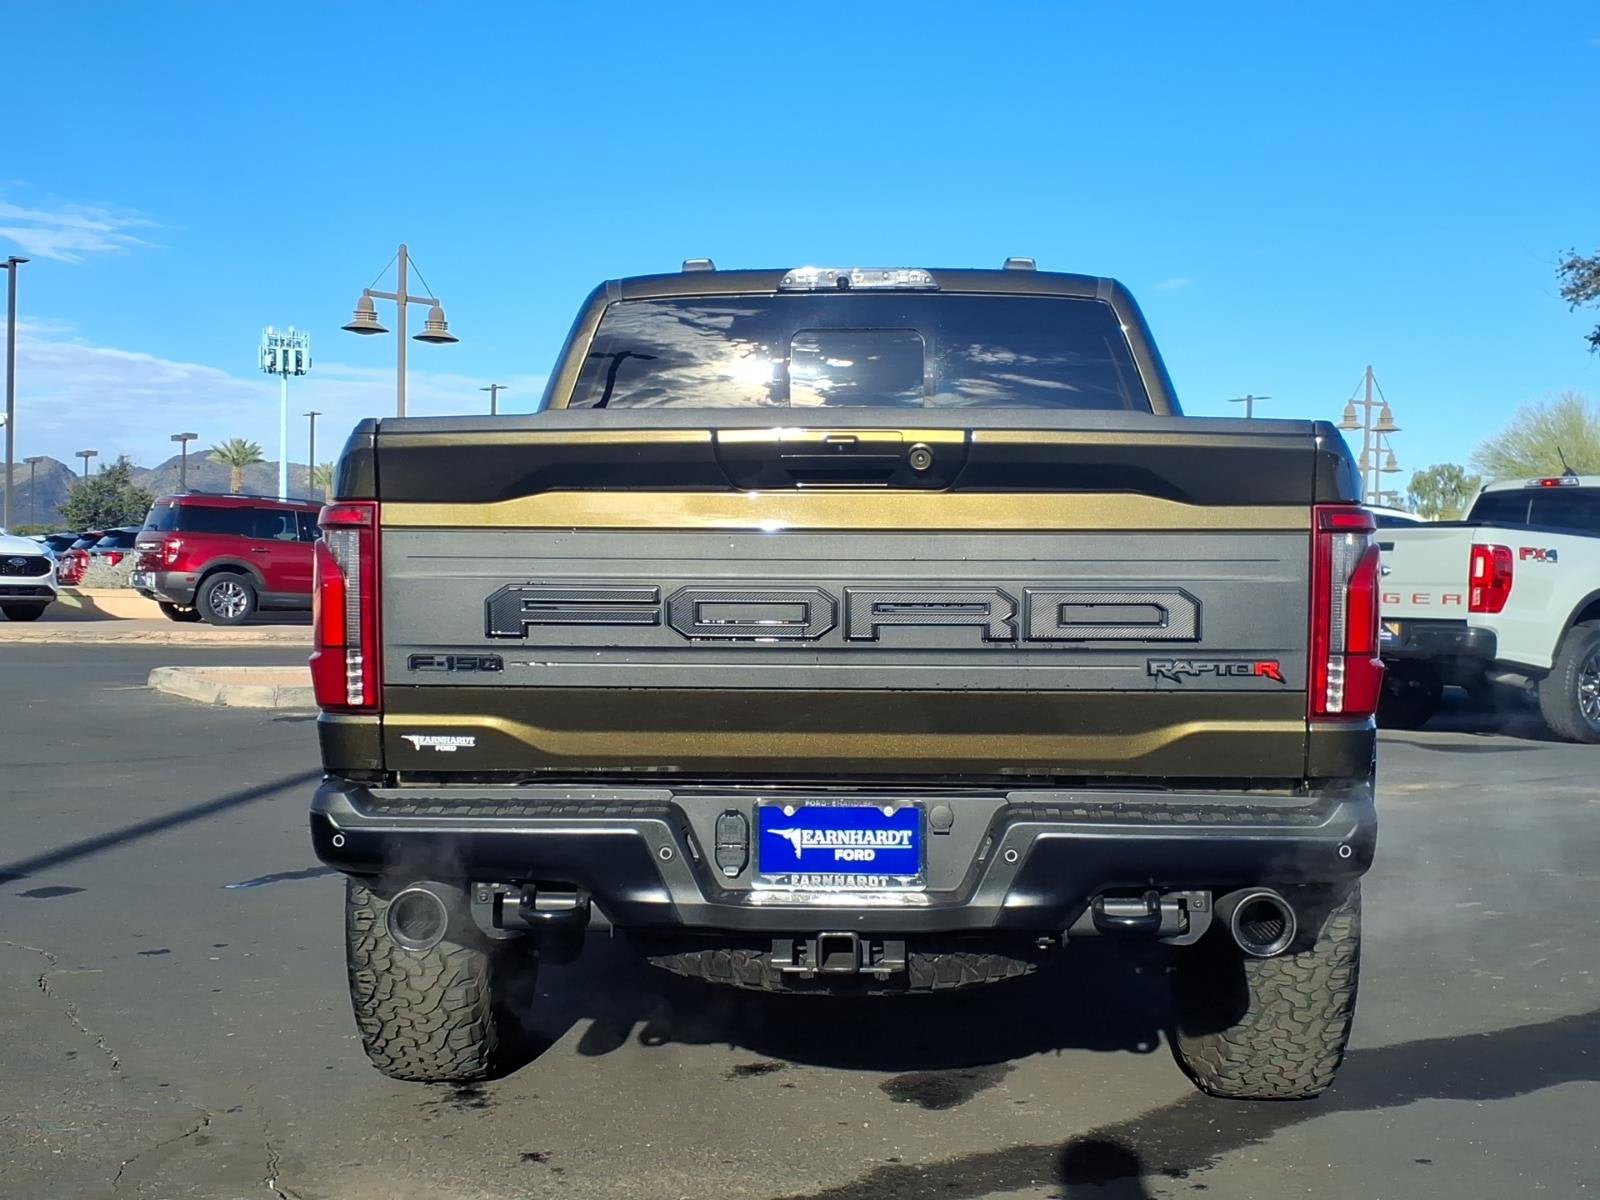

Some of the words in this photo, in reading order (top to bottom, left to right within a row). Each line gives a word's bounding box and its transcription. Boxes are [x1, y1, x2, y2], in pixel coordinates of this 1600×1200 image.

[1518, 546, 1558, 561] FX4
[1381, 592, 1462, 605] GER
[485, 583, 1202, 643] FORD
[407, 654, 504, 672] F-150
[1147, 658, 1286, 684] RAPTOR
[419, 735, 476, 746] EARNHARDT
[802, 829, 912, 846] EARNHARDT
[834, 849, 876, 861] FORD
[791, 874, 889, 888] EARNHARDT
